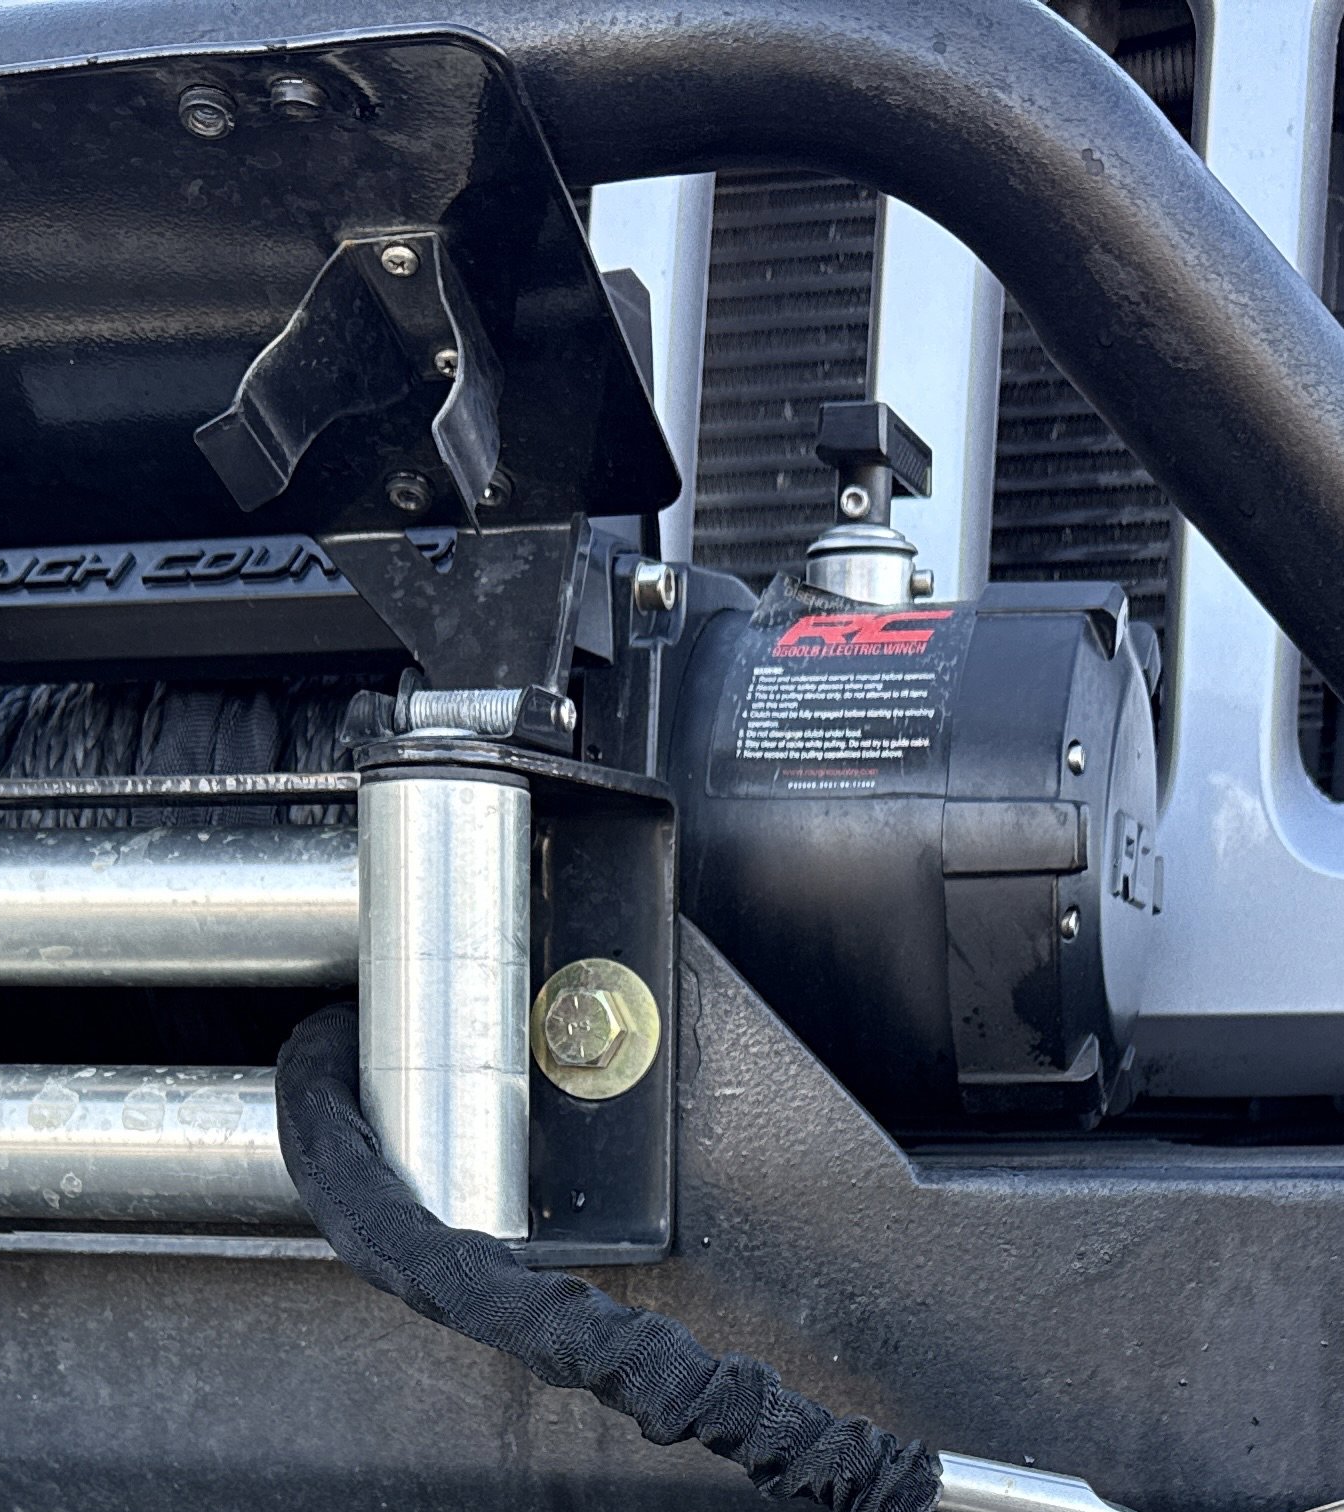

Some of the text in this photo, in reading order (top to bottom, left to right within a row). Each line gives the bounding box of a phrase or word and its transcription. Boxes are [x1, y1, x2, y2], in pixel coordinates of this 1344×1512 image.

[778, 610, 954, 645] RC
[772, 641, 928, 658] 9500LB ELECTRIC WINCH
[790, 674, 828, 683] understand
[881, 673, 903, 681] before
[756, 684, 778, 693] Always
[779, 684, 796, 692] wear
[796, 684, 817, 693] safety
[817, 683, 843, 692] glasses
[755, 692, 768, 700] This
[781, 692, 804, 701] pulling
[804, 691, 826, 700] device
[843, 691, 853, 700] do
[866, 691, 892, 700] attempt
[750, 710, 771, 719] Clutch
[772, 710, 788, 718] must
[799, 709, 813, 720] fully
[813, 709, 843, 720] engaged
[843, 709, 866, 718] before
[866, 709, 892, 719] starting
[892, 708, 904, 717] the
[904, 708, 935, 719] winching
[746, 730, 757, 738] Do
[757, 730, 768, 738] not
[768, 730, 803, 739] disengage
[804, 730, 824, 738] clutch
[824, 729, 844, 738] under
[745, 739, 760, 749] Stay
[760, 740, 777, 748] clear
[785, 740, 804, 748] cable
[804, 740, 823, 749] while
[823, 740, 846, 750] pulling.
[849, 740, 859, 748] Do
[859, 739, 872, 748] not
[872, 739, 882, 750] try
[890, 738, 910, 749] guide
[743, 749, 763, 759] Never
[763, 750, 788, 759] exceed
[788, 750, 800, 758] the
[800, 750, 823, 760] pulling
[823, 749, 861, 760] capabilities
[861, 749, 881, 758] listed
